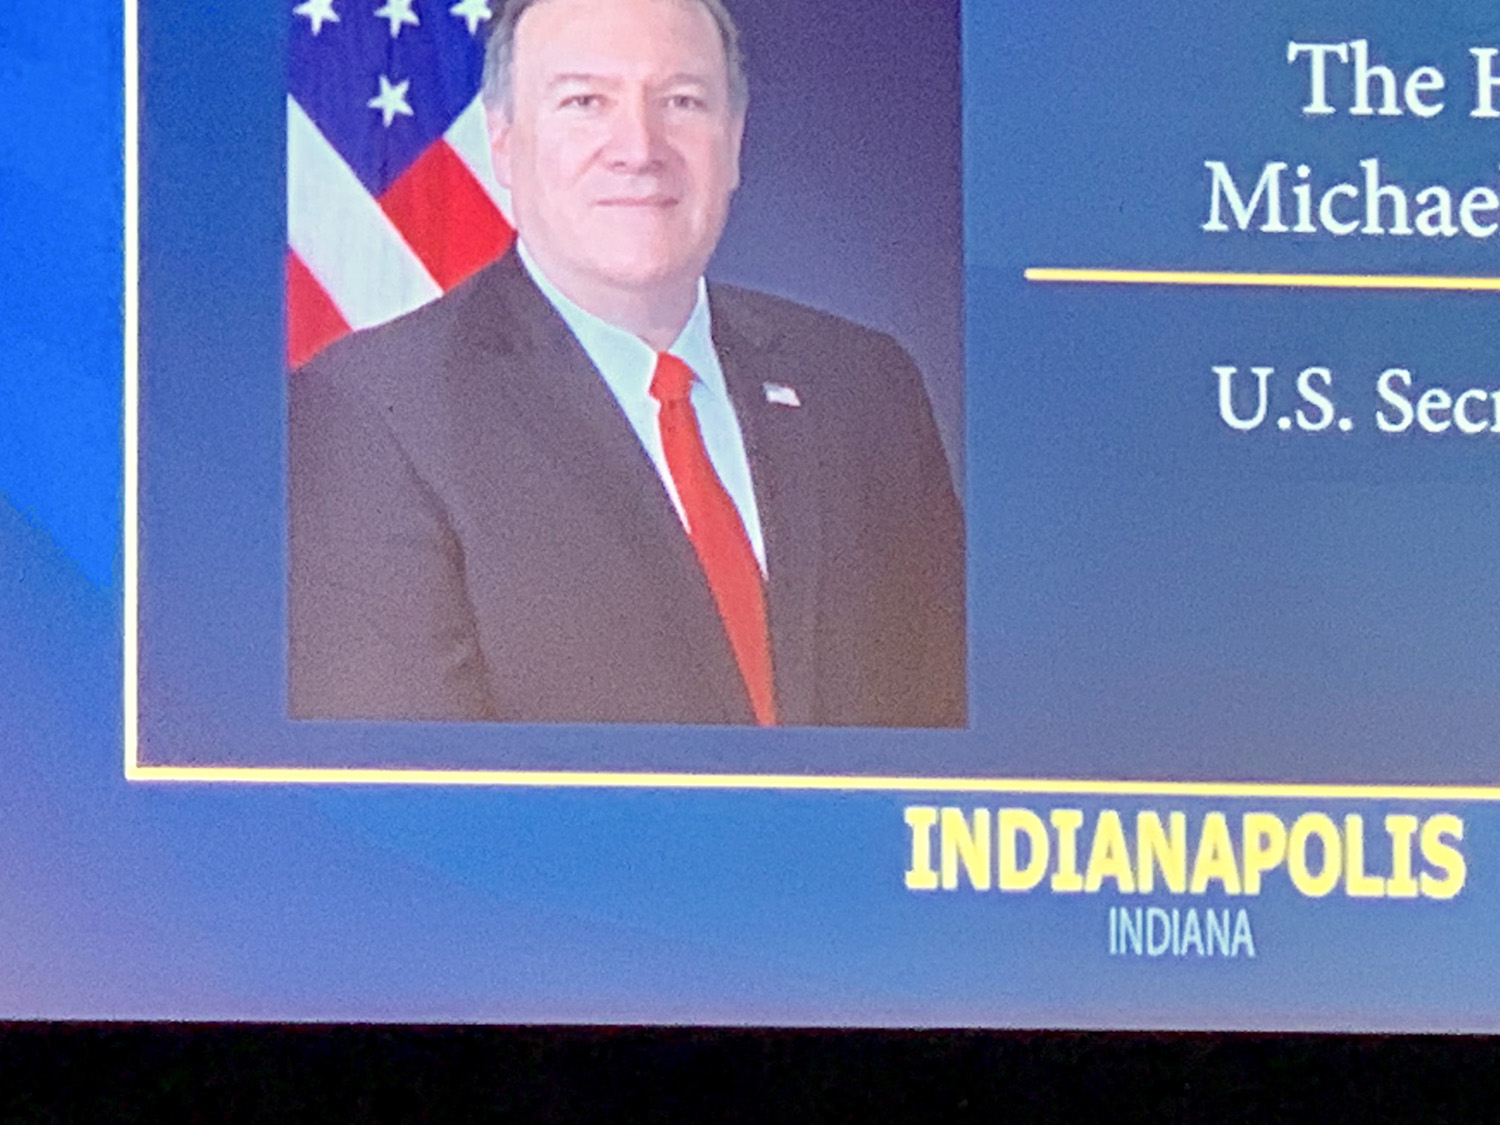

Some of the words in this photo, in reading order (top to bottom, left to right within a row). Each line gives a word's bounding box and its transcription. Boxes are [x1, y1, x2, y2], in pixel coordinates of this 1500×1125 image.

[1288, 40, 1445, 118] The
[1212, 366, 1353, 432] U.S.
[904, 807, 1467, 899] INDIANAPOLIS
[1109, 907, 1255, 957] INDIANA
